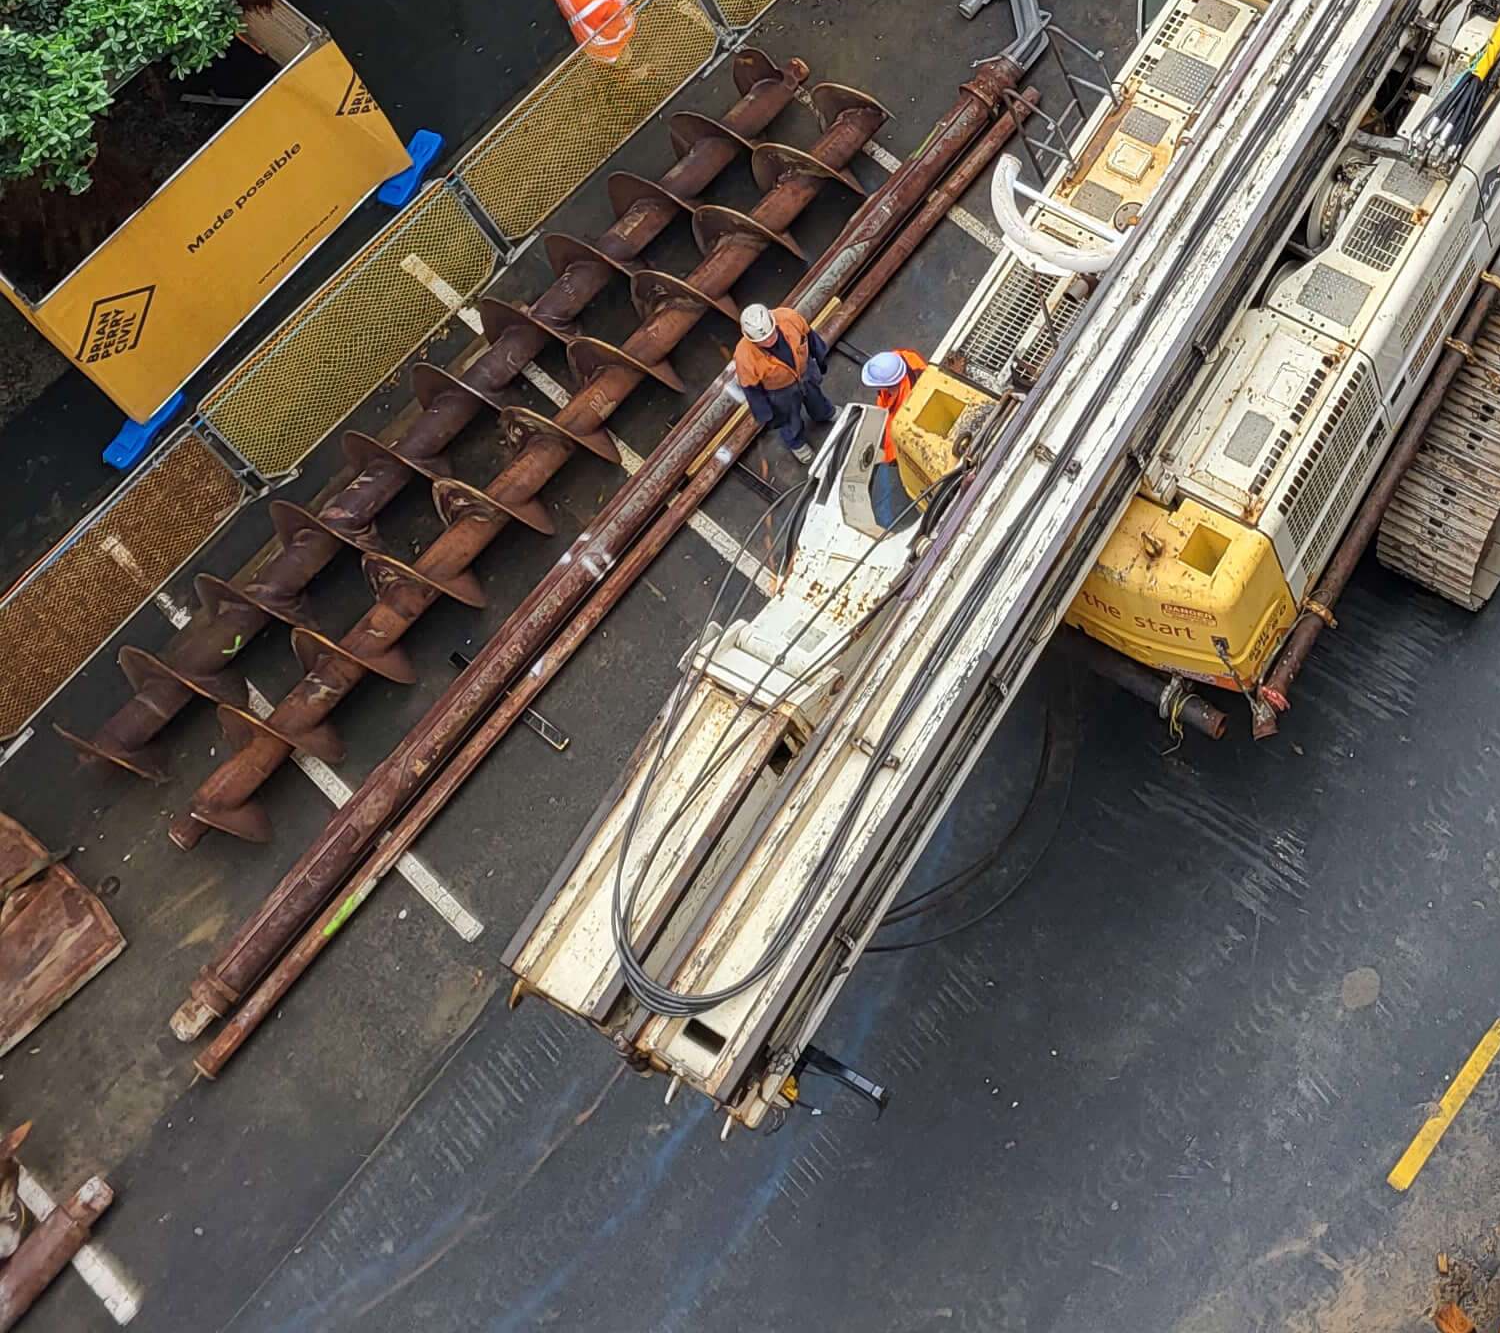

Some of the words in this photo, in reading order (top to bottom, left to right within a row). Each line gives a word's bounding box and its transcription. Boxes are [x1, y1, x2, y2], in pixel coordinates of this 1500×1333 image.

[186, 208, 235, 254] Made
[234, 142, 302, 210] possible
[85, 311, 113, 364] BRIAN
[100, 308, 125, 360] PERRY
[114, 312, 137, 355] CIVIL
[1082, 589, 1122, 620] the
[1134, 614, 1197, 641] start
